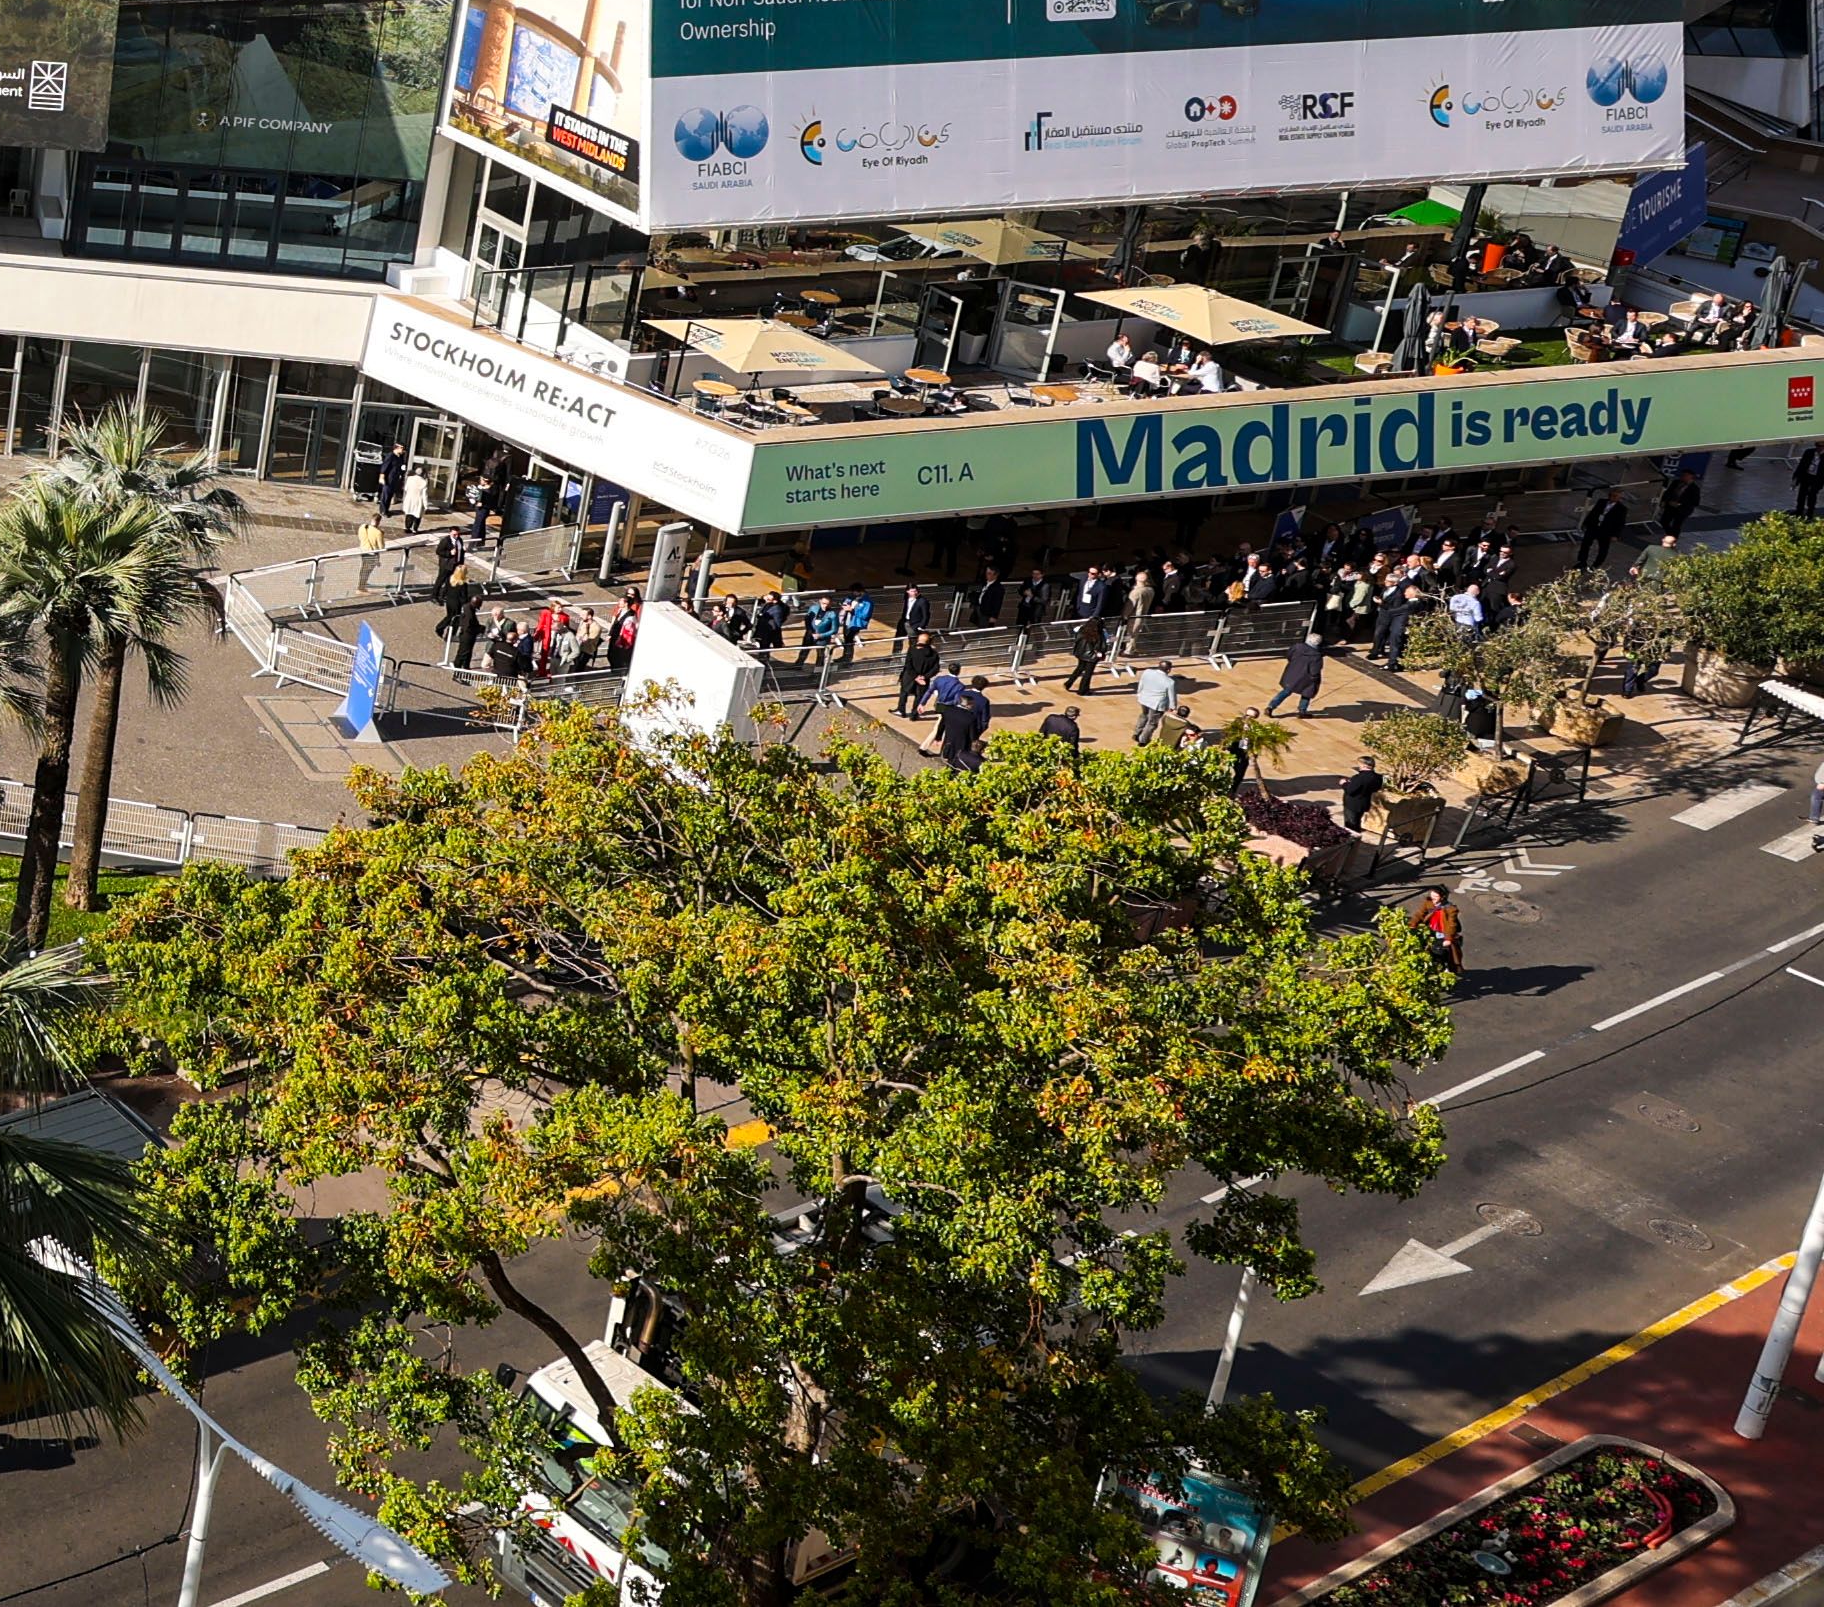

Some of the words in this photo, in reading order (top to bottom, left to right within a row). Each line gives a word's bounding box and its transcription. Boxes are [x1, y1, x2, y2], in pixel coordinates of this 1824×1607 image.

[680, 18, 776, 43] Ownership
[219, 116, 230, 127] A
[233, 116, 256, 128] PIF
[258, 118, 333, 134] COMPANY
[1485, 121, 1501, 130] Eye
[1503, 119, 1514, 128] Of
[1516, 117, 1546, 128] Riyadh
[1606, 106, 1649, 121] FIABCI
[555, 111, 565, 126] IT
[564, 115, 599, 142] STARTS
[598, 129, 610, 146] IN
[610, 135, 629, 156] THE
[1601, 125, 1624, 134] SAUDI
[1625, 123, 1653, 132] ARABIA
[552, 126, 578, 149] WEST
[577, 137, 626, 171] MIDLANDS
[1191, 138, 1226, 149] PropTech
[697, 162, 747, 177] FIABCI
[862, 158, 880, 168] Eye
[883, 156, 895, 166] Of
[896, 155, 928, 167] Riyadh
[692, 181, 719, 191] SAUDI
[721, 179, 753, 189] ARABIA
[1639, 178, 1683, 224] TOURISME
[390, 322, 526, 392] STOCKHOLM
[533, 380, 617, 428] RE:ACT
[1076, 394, 1434, 499] Madrid
[1451, 400, 1490, 449] is
[1504, 388, 1652, 446] ready
[785, 462, 845, 484] What's
[849, 459, 886, 480] next
[917, 464, 954, 486] C11.
[956, 461, 974, 483] A
[785, 484, 835, 504] starts
[840, 480, 879, 500] here
